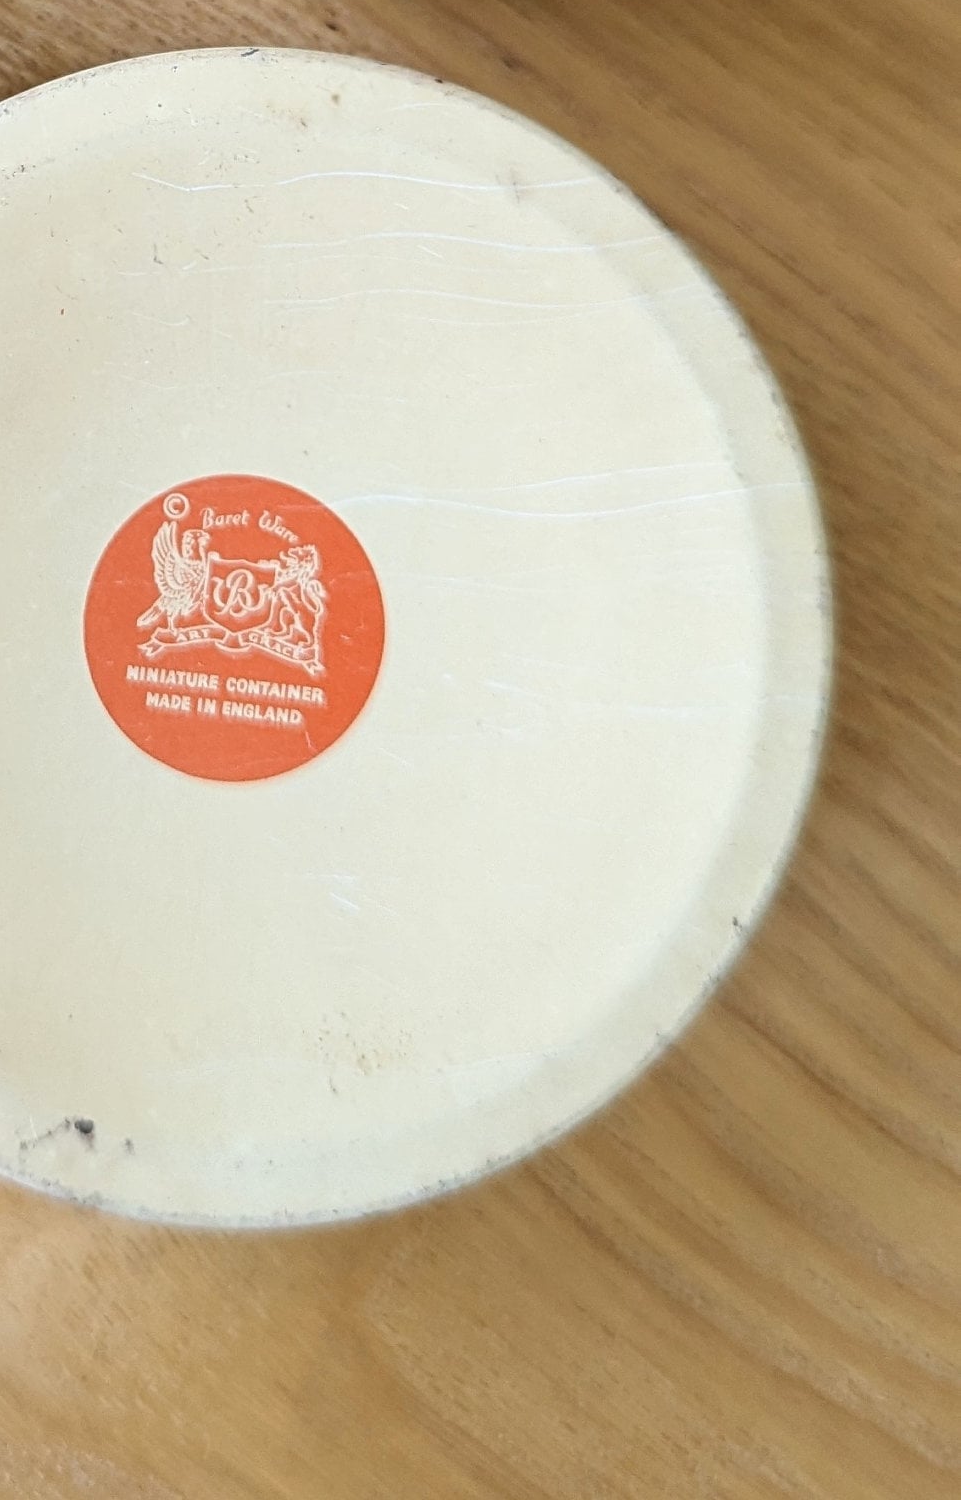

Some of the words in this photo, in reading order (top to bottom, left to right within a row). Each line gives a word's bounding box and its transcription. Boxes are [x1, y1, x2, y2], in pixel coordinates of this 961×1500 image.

[200, 507, 250, 529] Baret
[258, 509, 299, 543] Ware
[176, 628, 210, 643] ART
[126, 664, 219, 690] MINIATURE
[226, 676, 325, 703] CONTAINER
[145, 691, 191, 711] MADE
[197, 697, 216, 714] IN
[222, 700, 303, 724] ENGLAND
